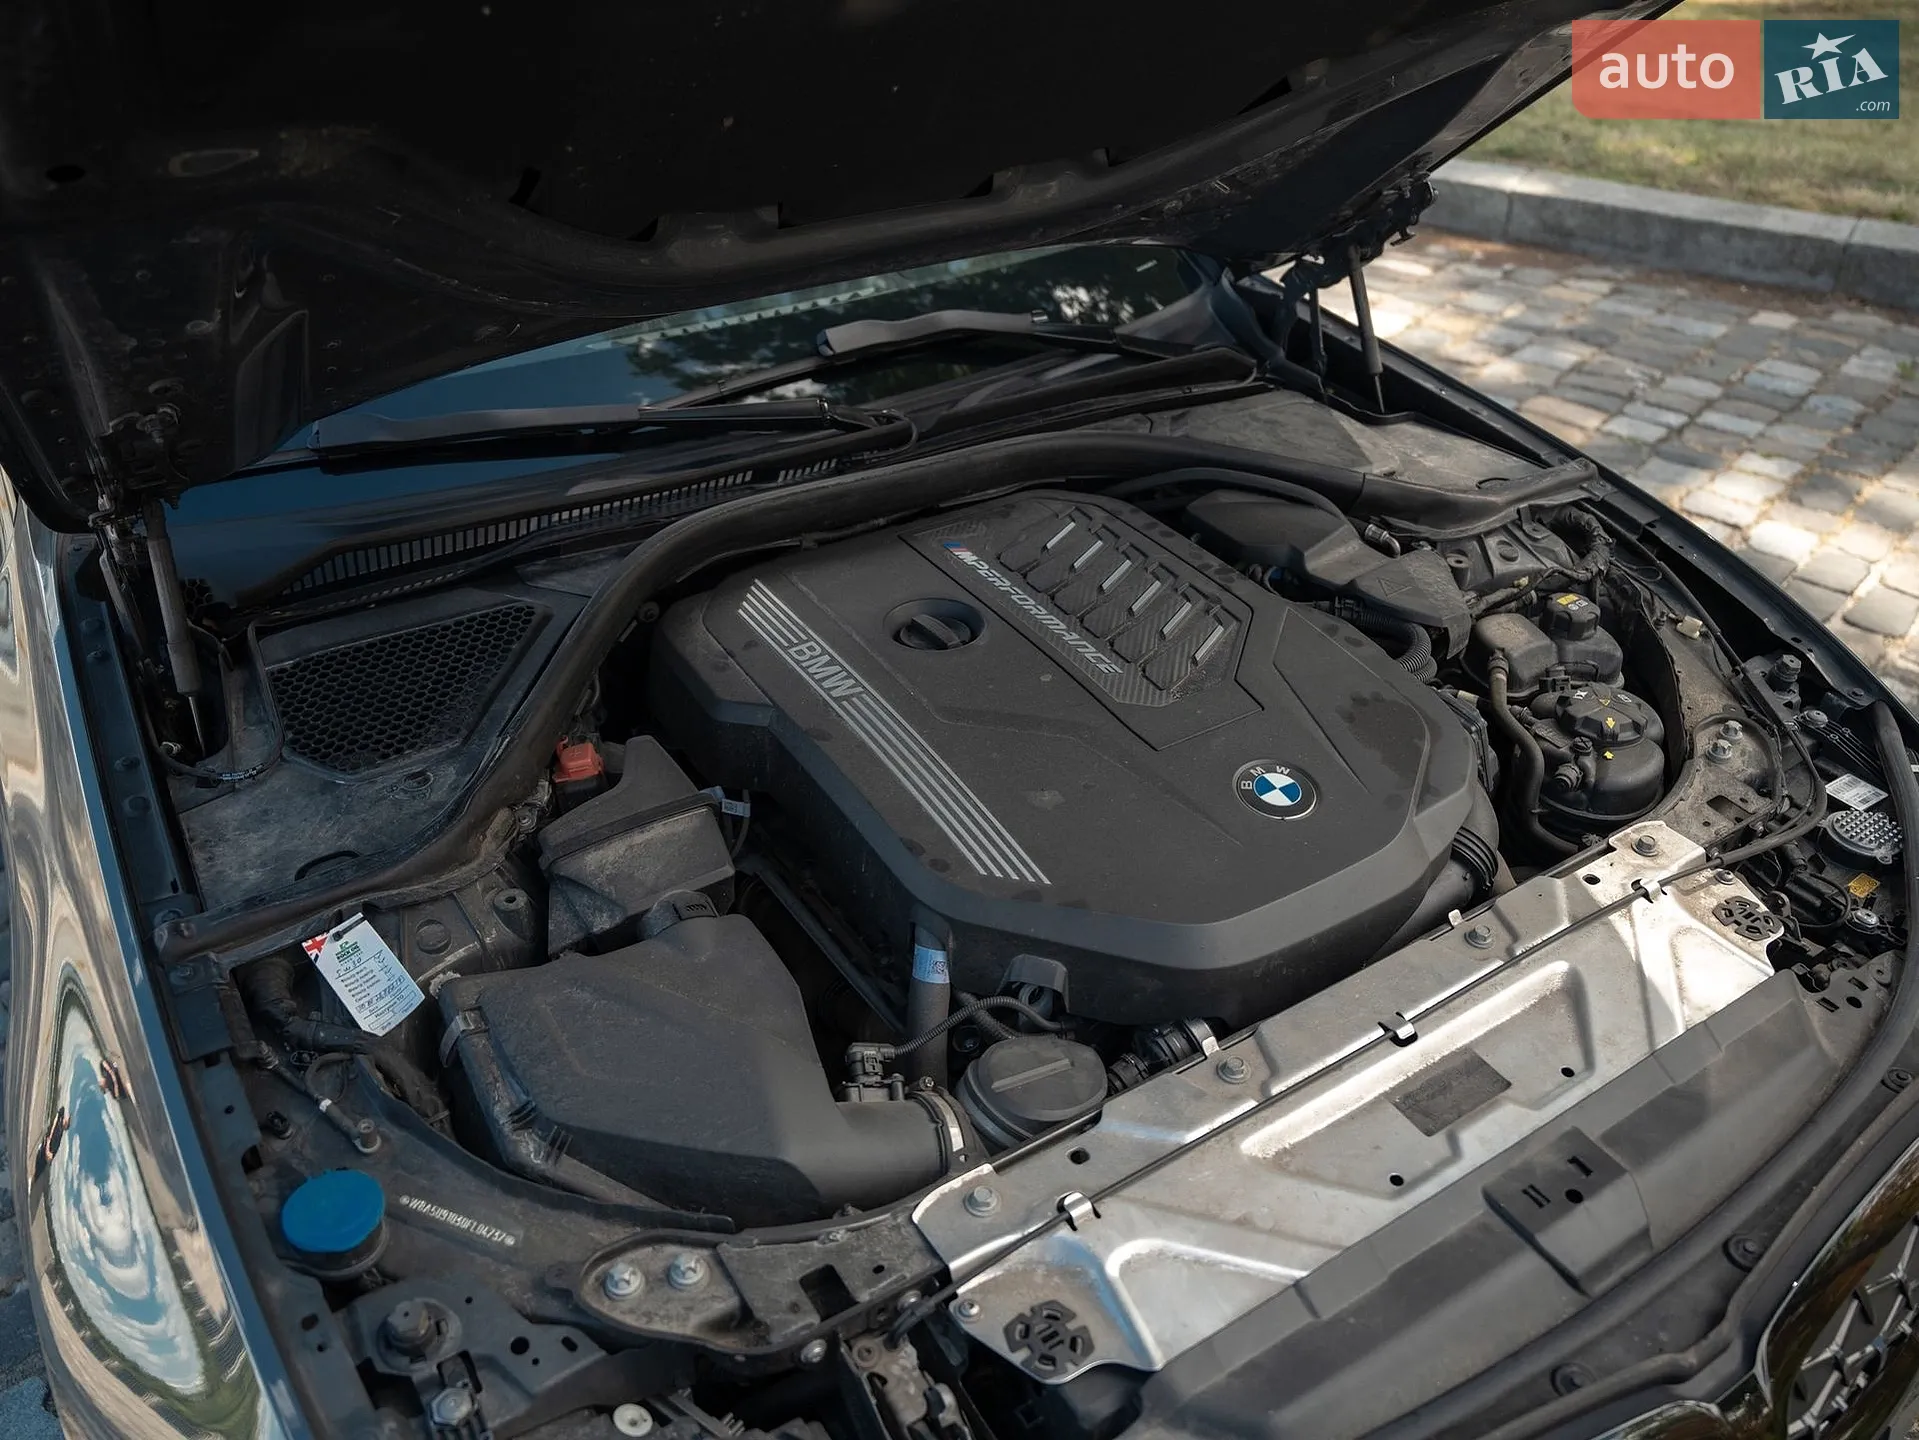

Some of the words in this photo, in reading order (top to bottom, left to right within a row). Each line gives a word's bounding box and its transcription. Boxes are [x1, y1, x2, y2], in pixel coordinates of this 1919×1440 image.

[968, 560, 1124, 675] PERFORMANCE
[785, 637, 865, 699] BMW
[1240, 765, 1291, 790] BMW
